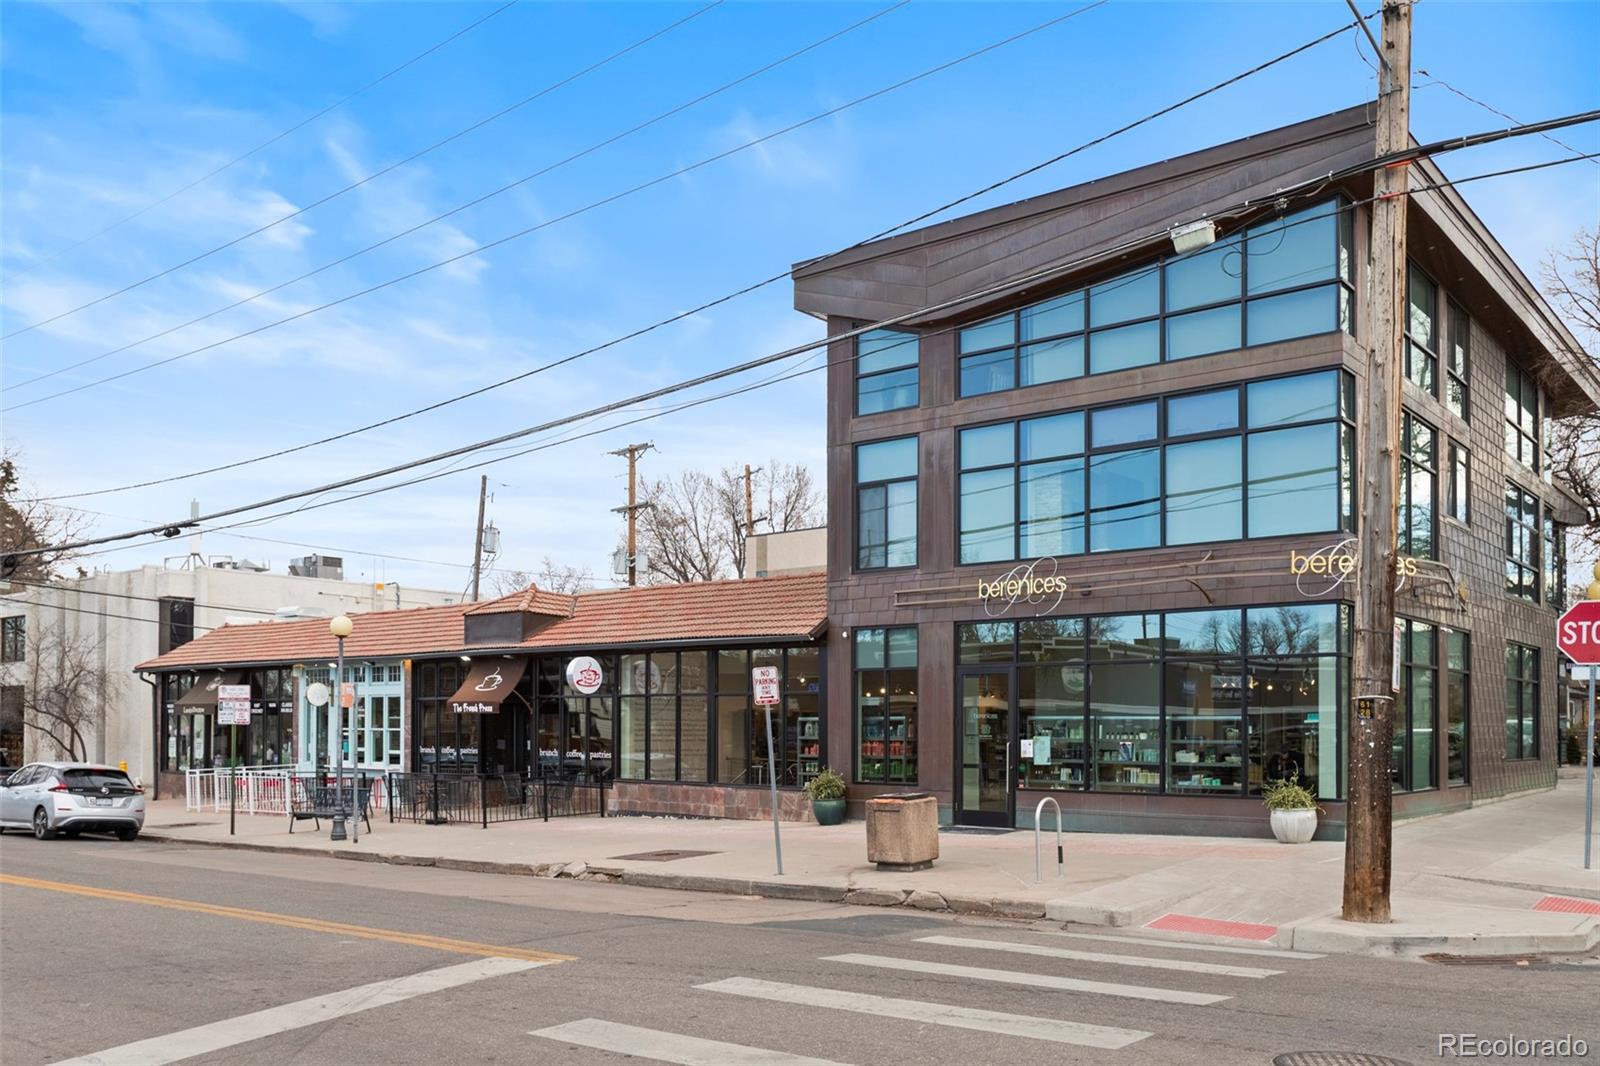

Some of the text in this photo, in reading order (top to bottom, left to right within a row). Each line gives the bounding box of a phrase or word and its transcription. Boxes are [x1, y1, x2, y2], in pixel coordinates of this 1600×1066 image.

[1290, 550, 1416, 576] berees
[978, 576, 1067, 599] berenices
[1562, 621, 1600, 645] STO
[755, 678, 777, 686] PARKING
[453, 703, 462, 712] The
[539, 748, 558, 757] brunch
[590, 751, 612, 760] pastries
